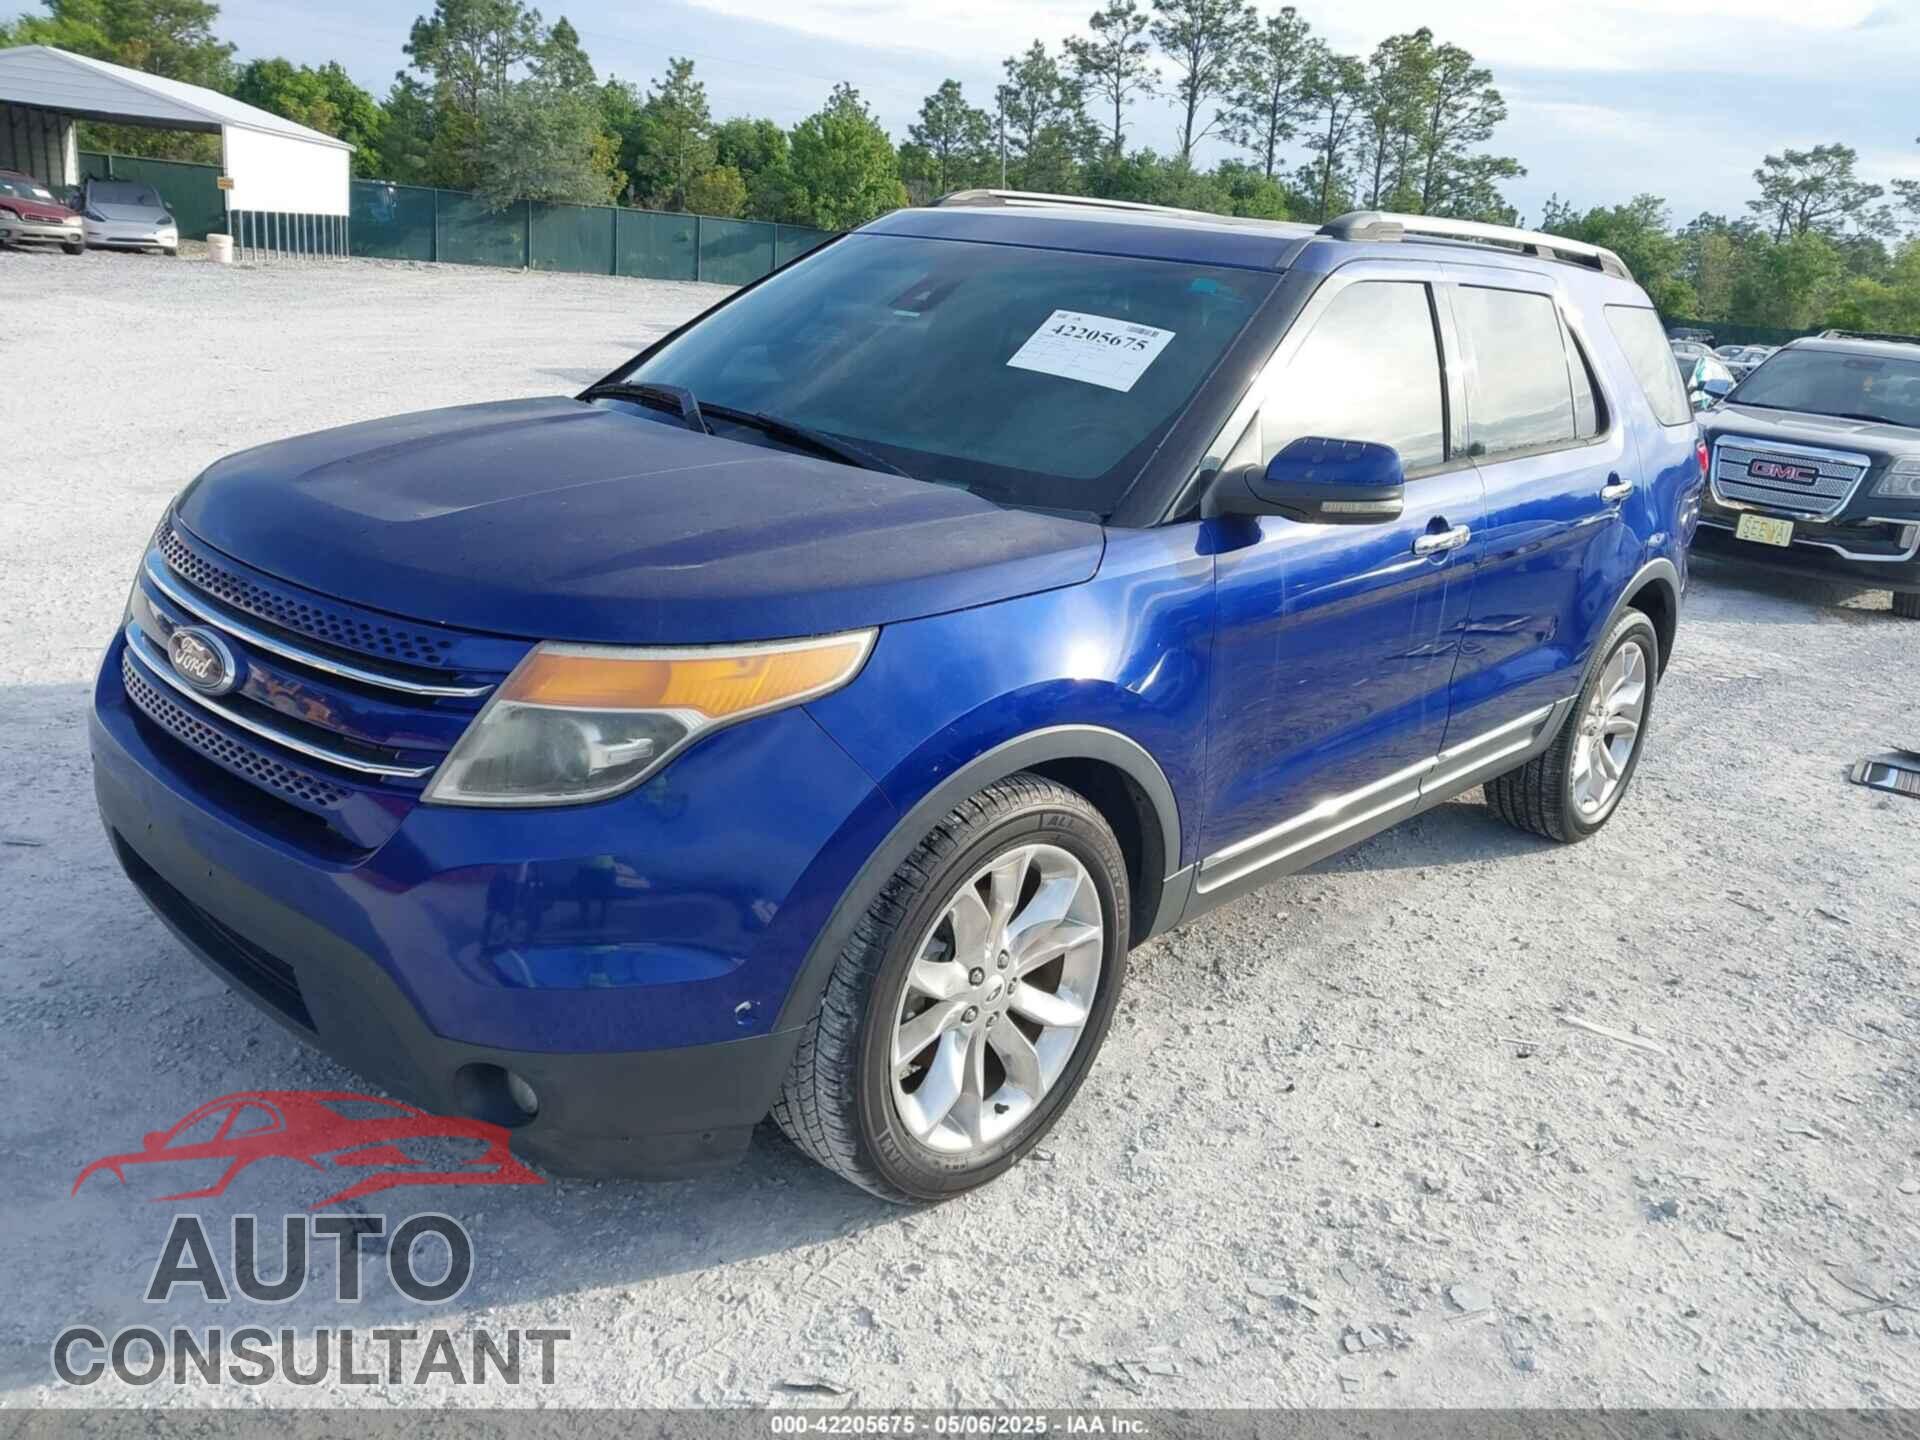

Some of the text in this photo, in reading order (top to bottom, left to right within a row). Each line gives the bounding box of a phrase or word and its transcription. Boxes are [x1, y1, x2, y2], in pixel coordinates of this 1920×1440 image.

[1052, 324, 1149, 351] 42205675
[1752, 461, 1816, 483] GMC
[175, 636, 212, 679] Ford
